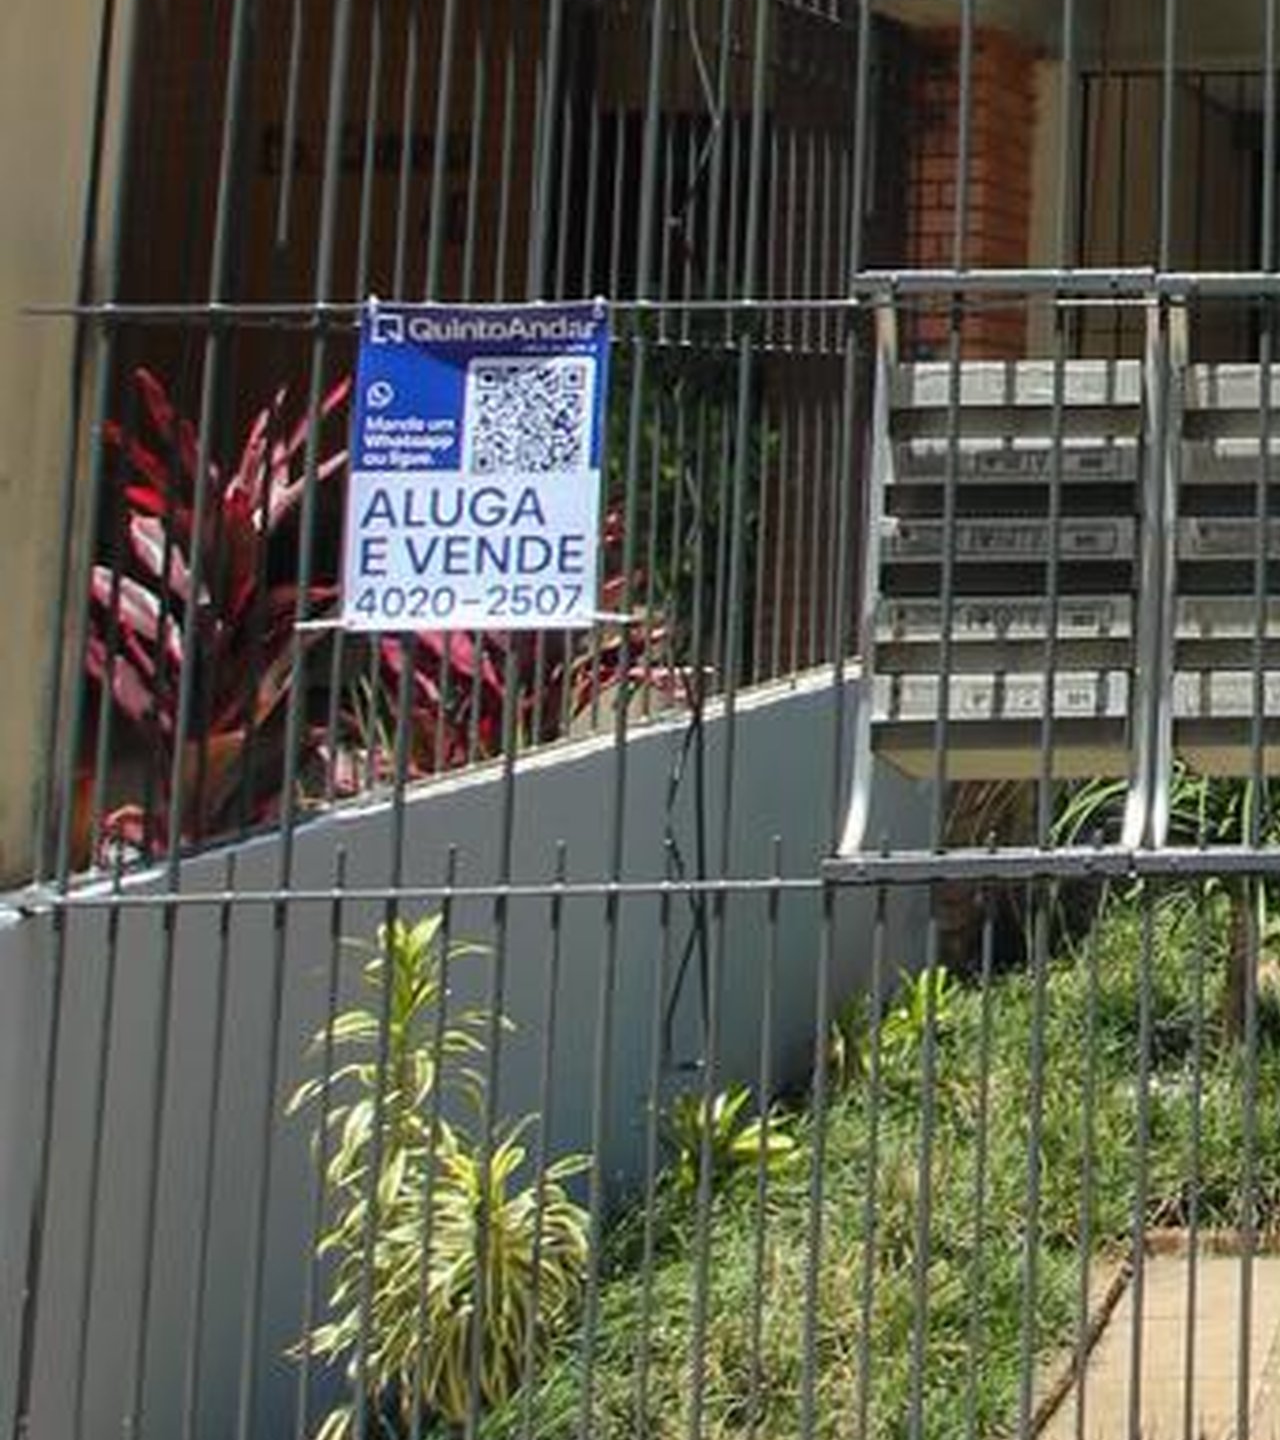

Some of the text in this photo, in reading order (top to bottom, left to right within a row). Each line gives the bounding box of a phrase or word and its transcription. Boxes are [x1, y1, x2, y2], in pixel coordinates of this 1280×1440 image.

[409, 317, 598, 343] QuintoAndar
[363, 453, 386, 466] ou
[360, 487, 545, 529] ALUGA
[360, 535, 585, 576] E VENDE
[355, 584, 582, 618] 4020-2507
